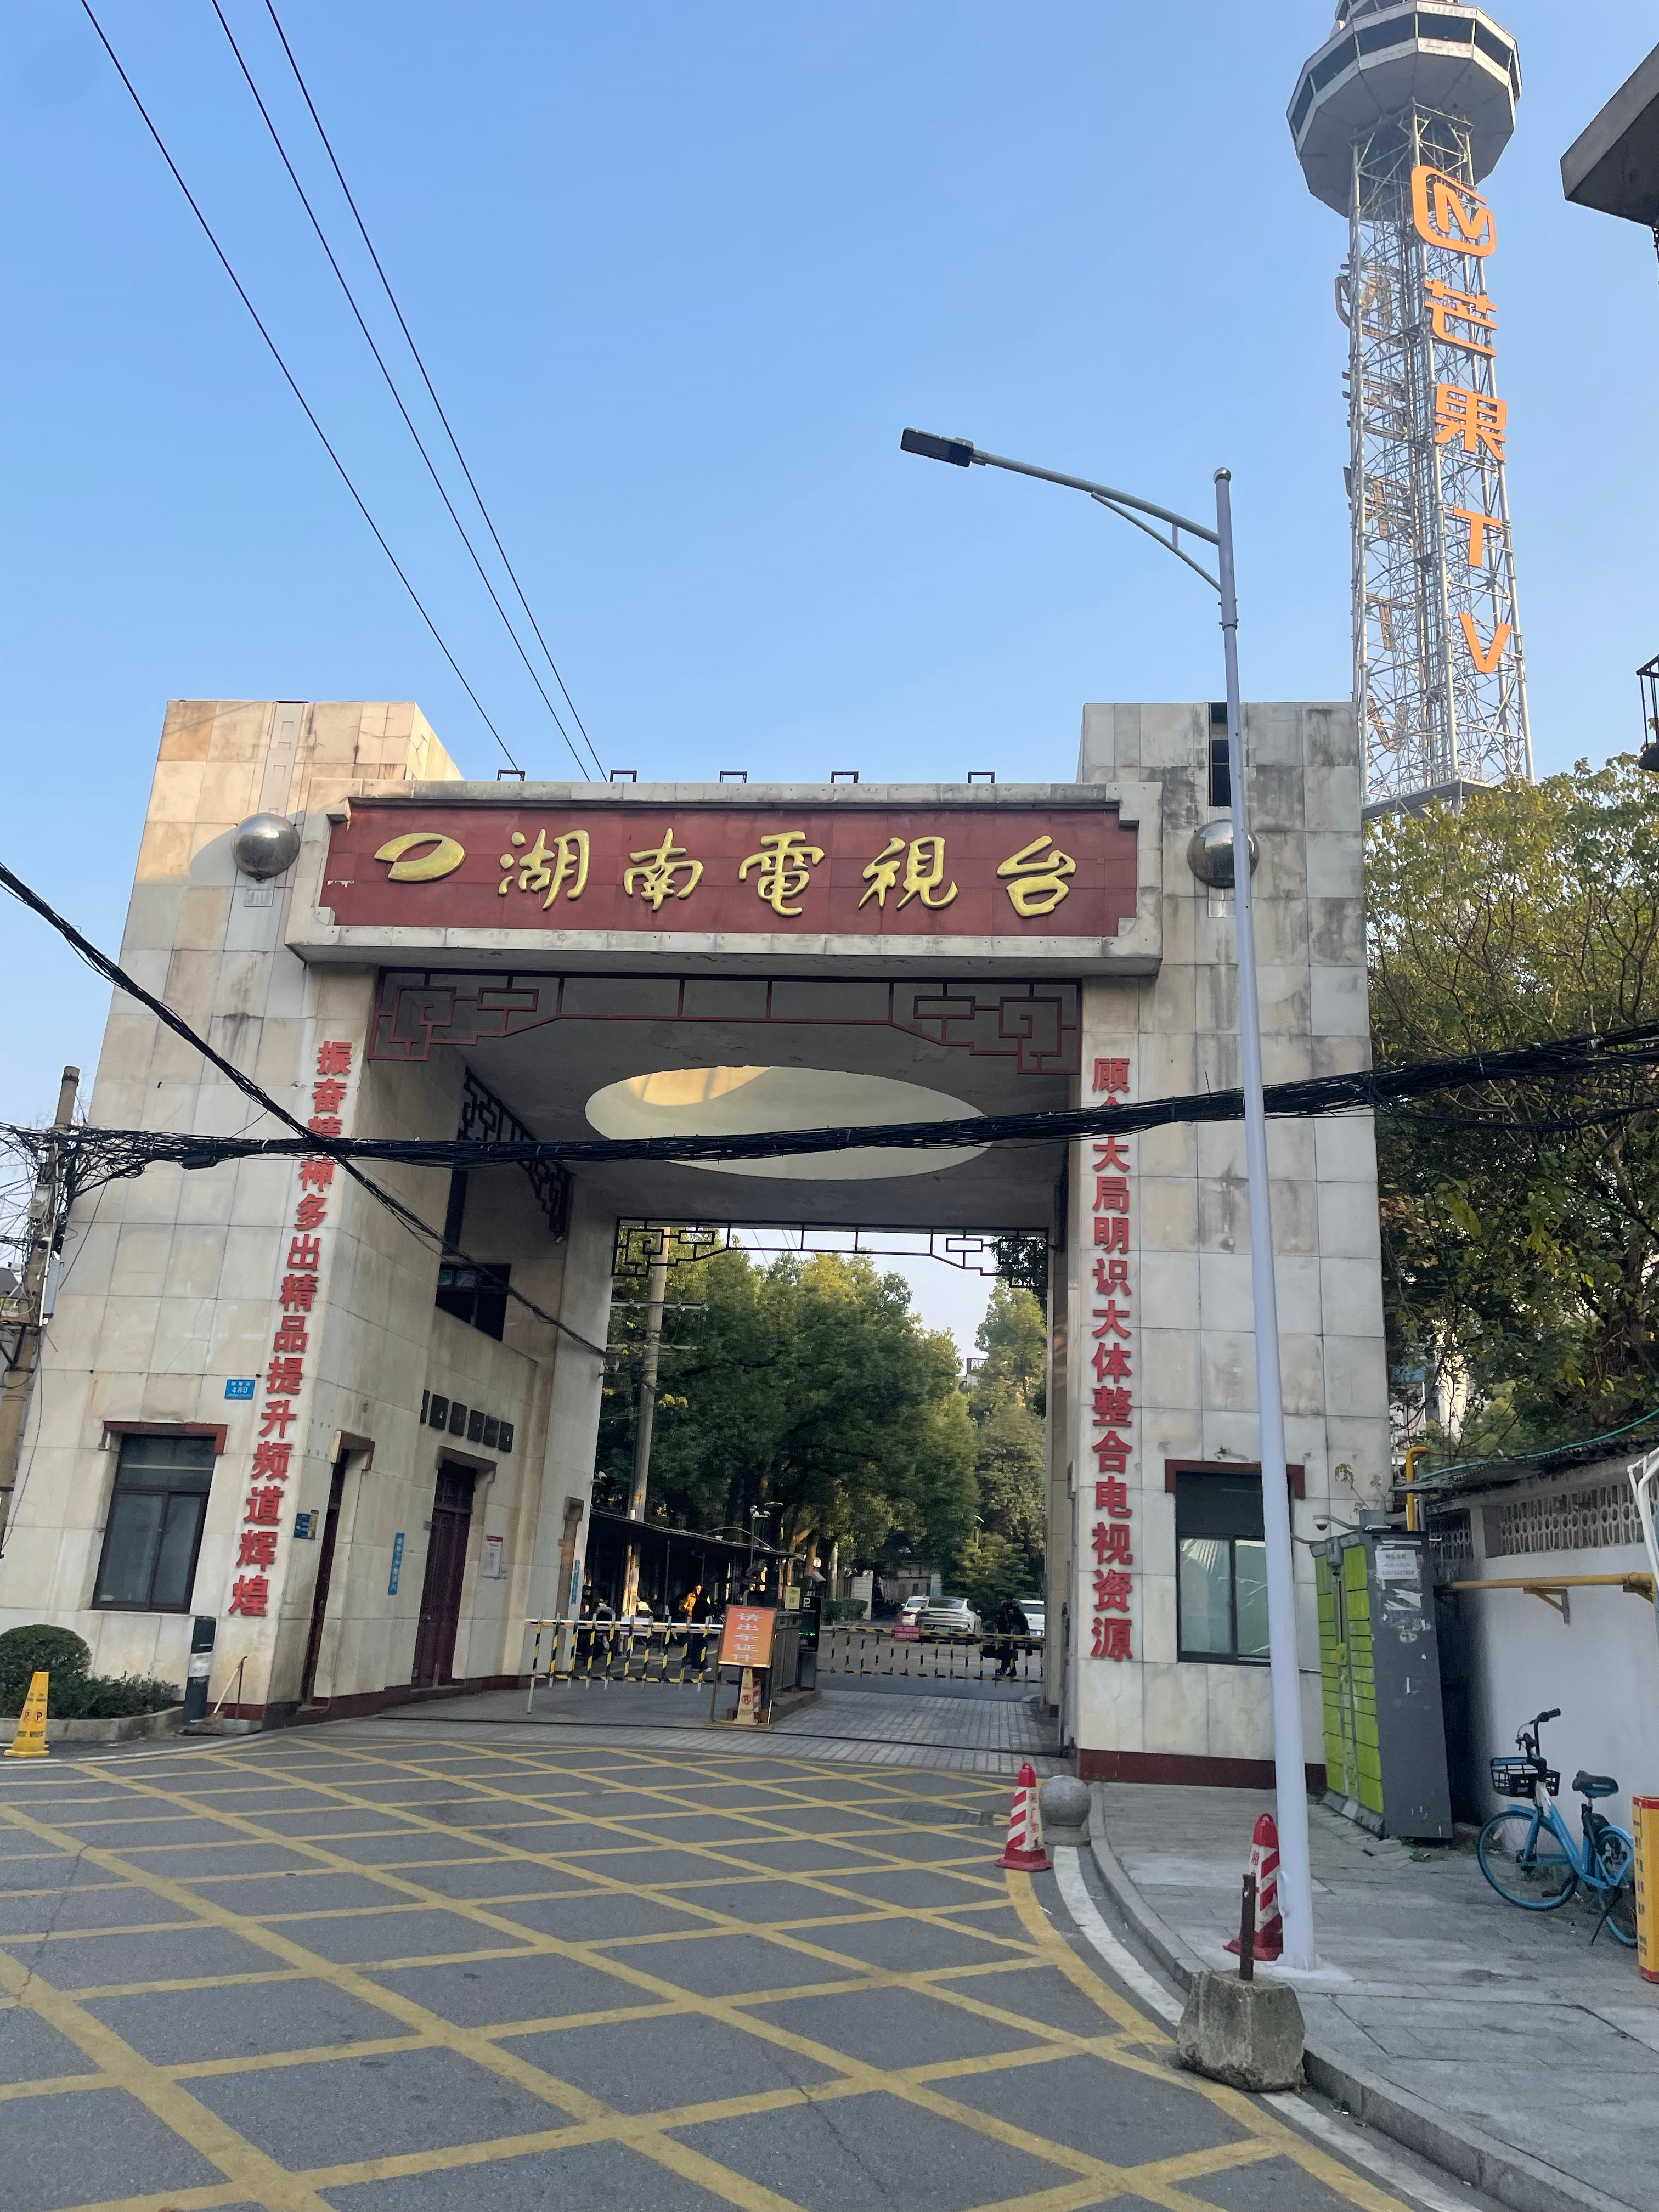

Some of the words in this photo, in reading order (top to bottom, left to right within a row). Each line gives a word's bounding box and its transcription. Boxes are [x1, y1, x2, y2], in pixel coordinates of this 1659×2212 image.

[731, 1612, 763, 1663] 请出示证件
